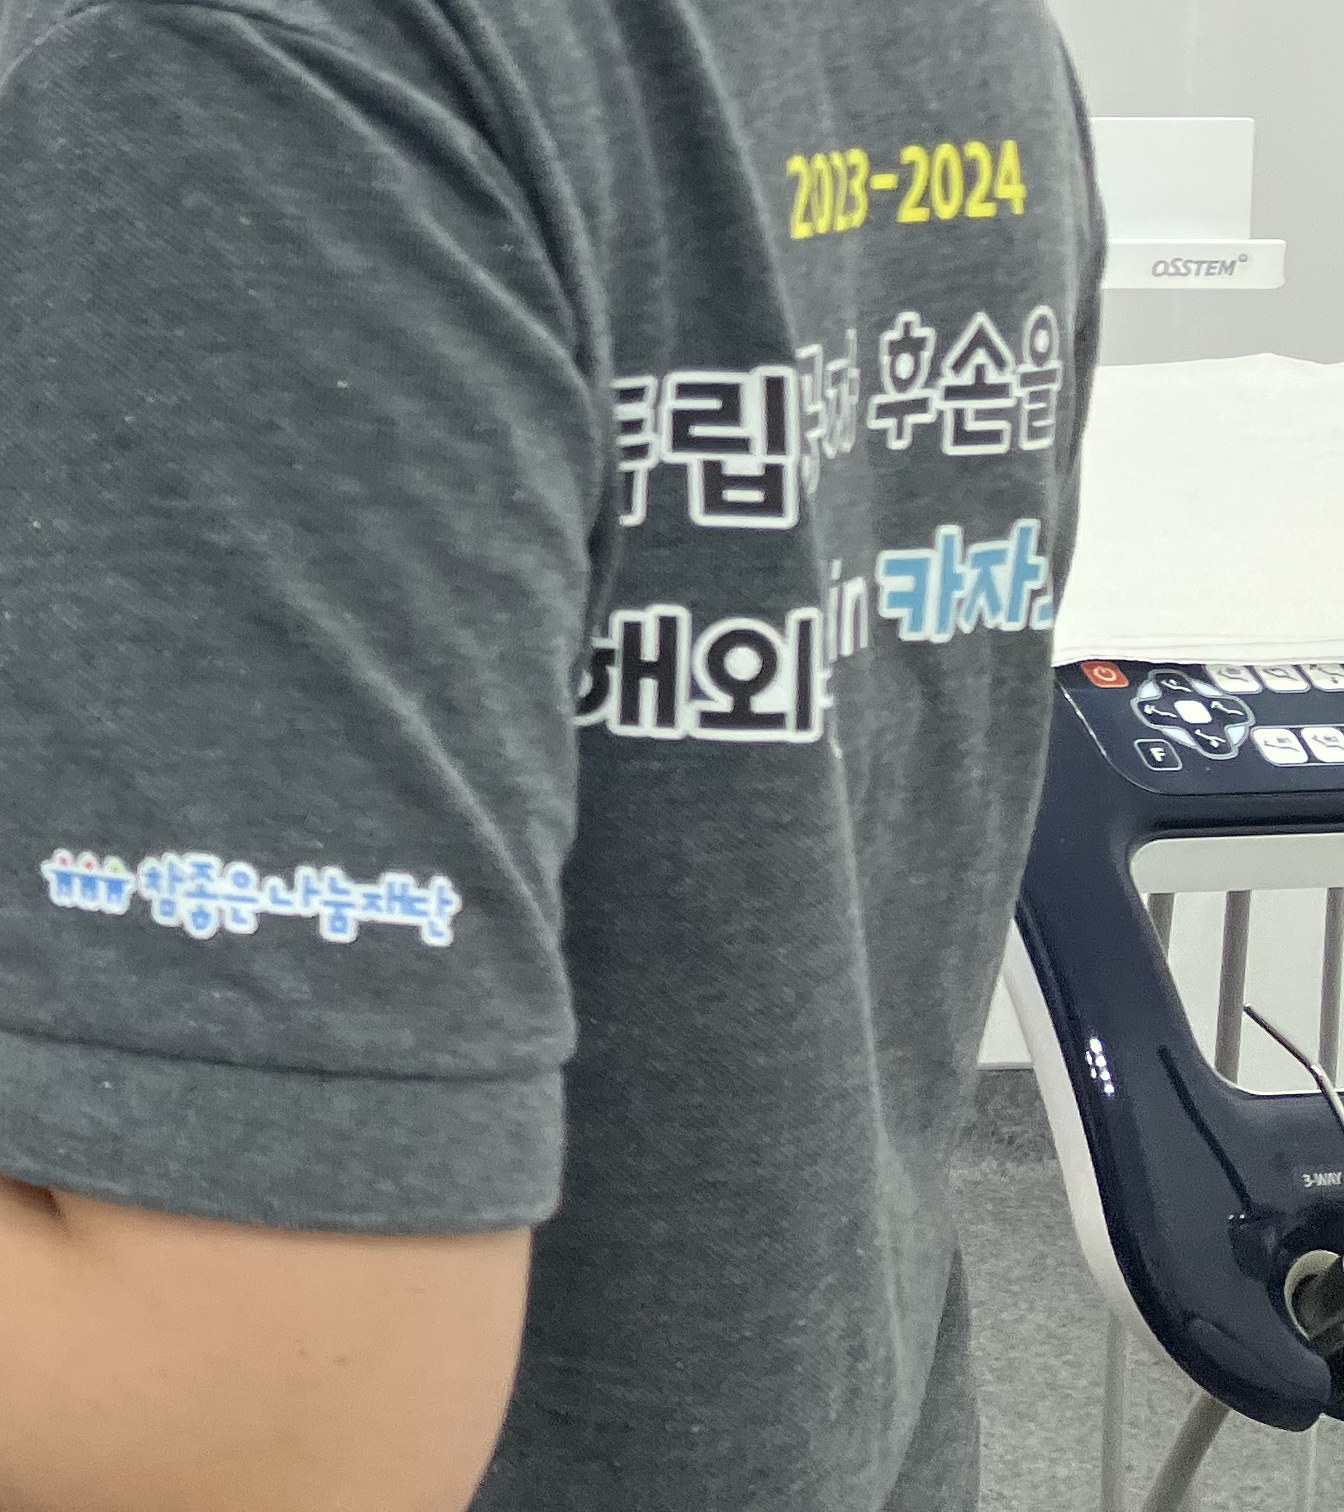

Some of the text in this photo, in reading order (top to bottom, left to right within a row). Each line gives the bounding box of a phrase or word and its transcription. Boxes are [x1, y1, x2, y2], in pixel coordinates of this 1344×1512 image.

[1151, 257, 1237, 278] OSSTEM
[866, 305, 1062, 456] 후손을
[1302, 1172, 1343, 1188] 3-WAY
